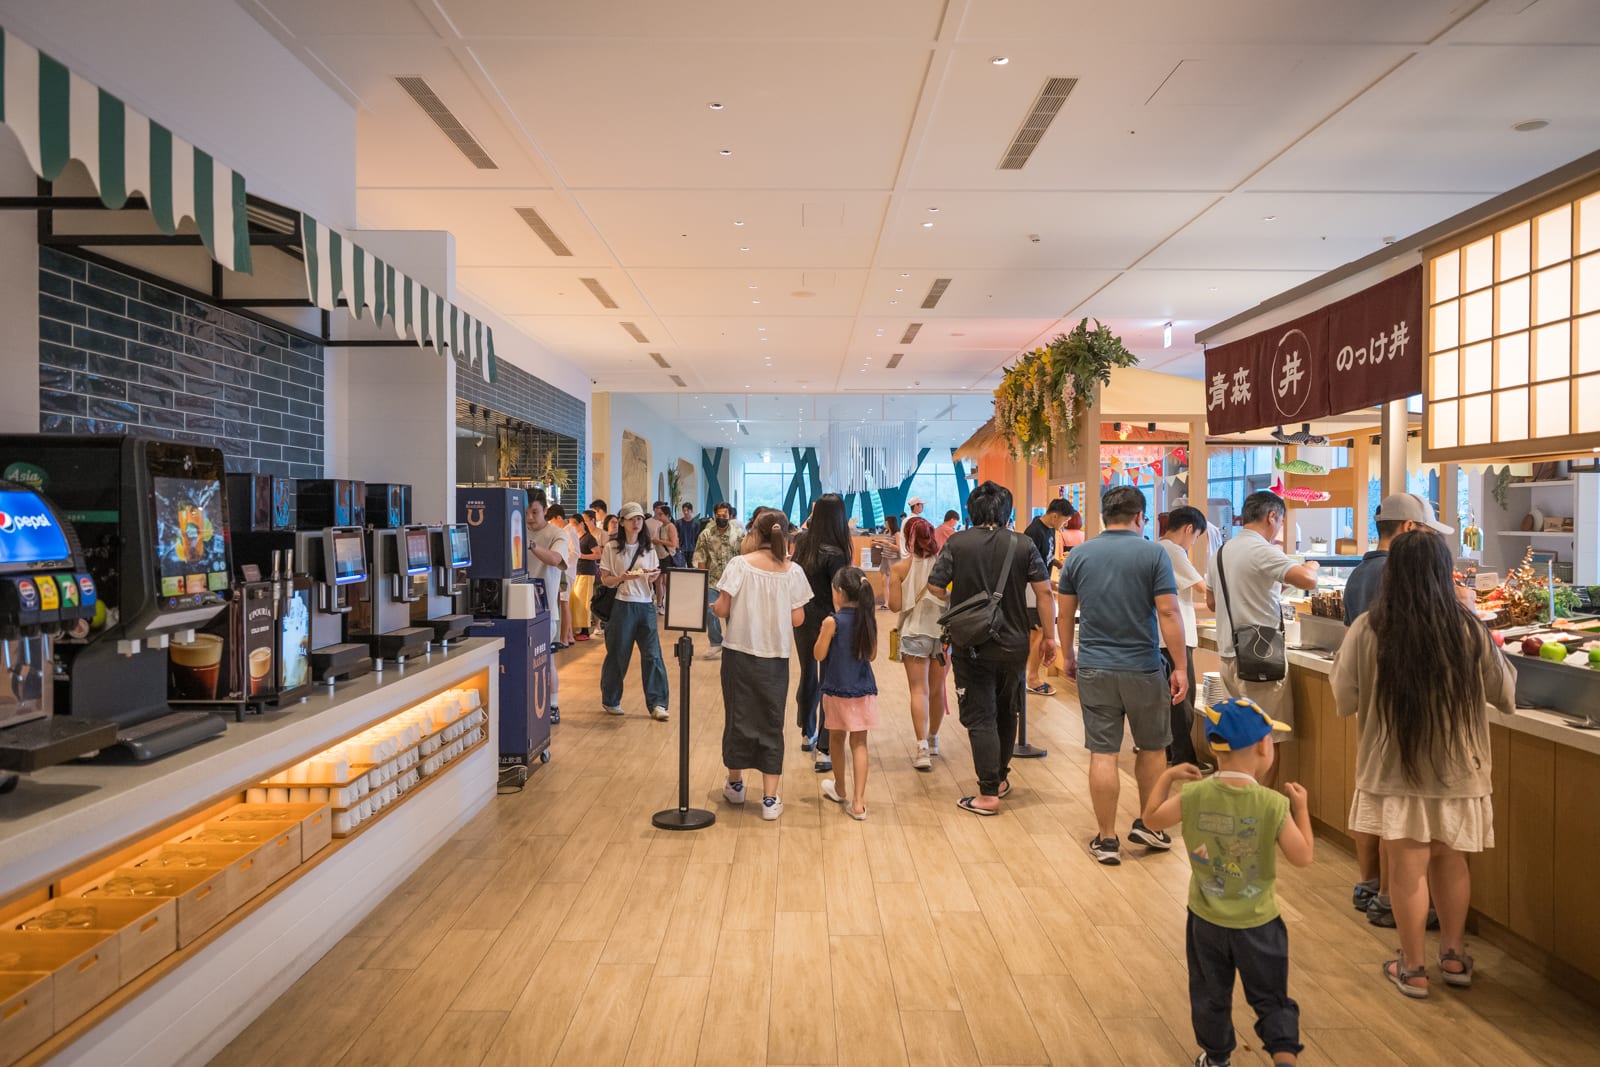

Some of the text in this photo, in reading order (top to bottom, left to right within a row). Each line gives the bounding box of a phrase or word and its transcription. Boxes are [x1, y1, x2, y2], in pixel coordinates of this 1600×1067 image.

[1208, 367, 1252, 411] 青森
[1336, 320, 1410, 372] のっけ丼
[8, 469, 39, 482] Asia
[14, 513, 51, 529] pepsi
